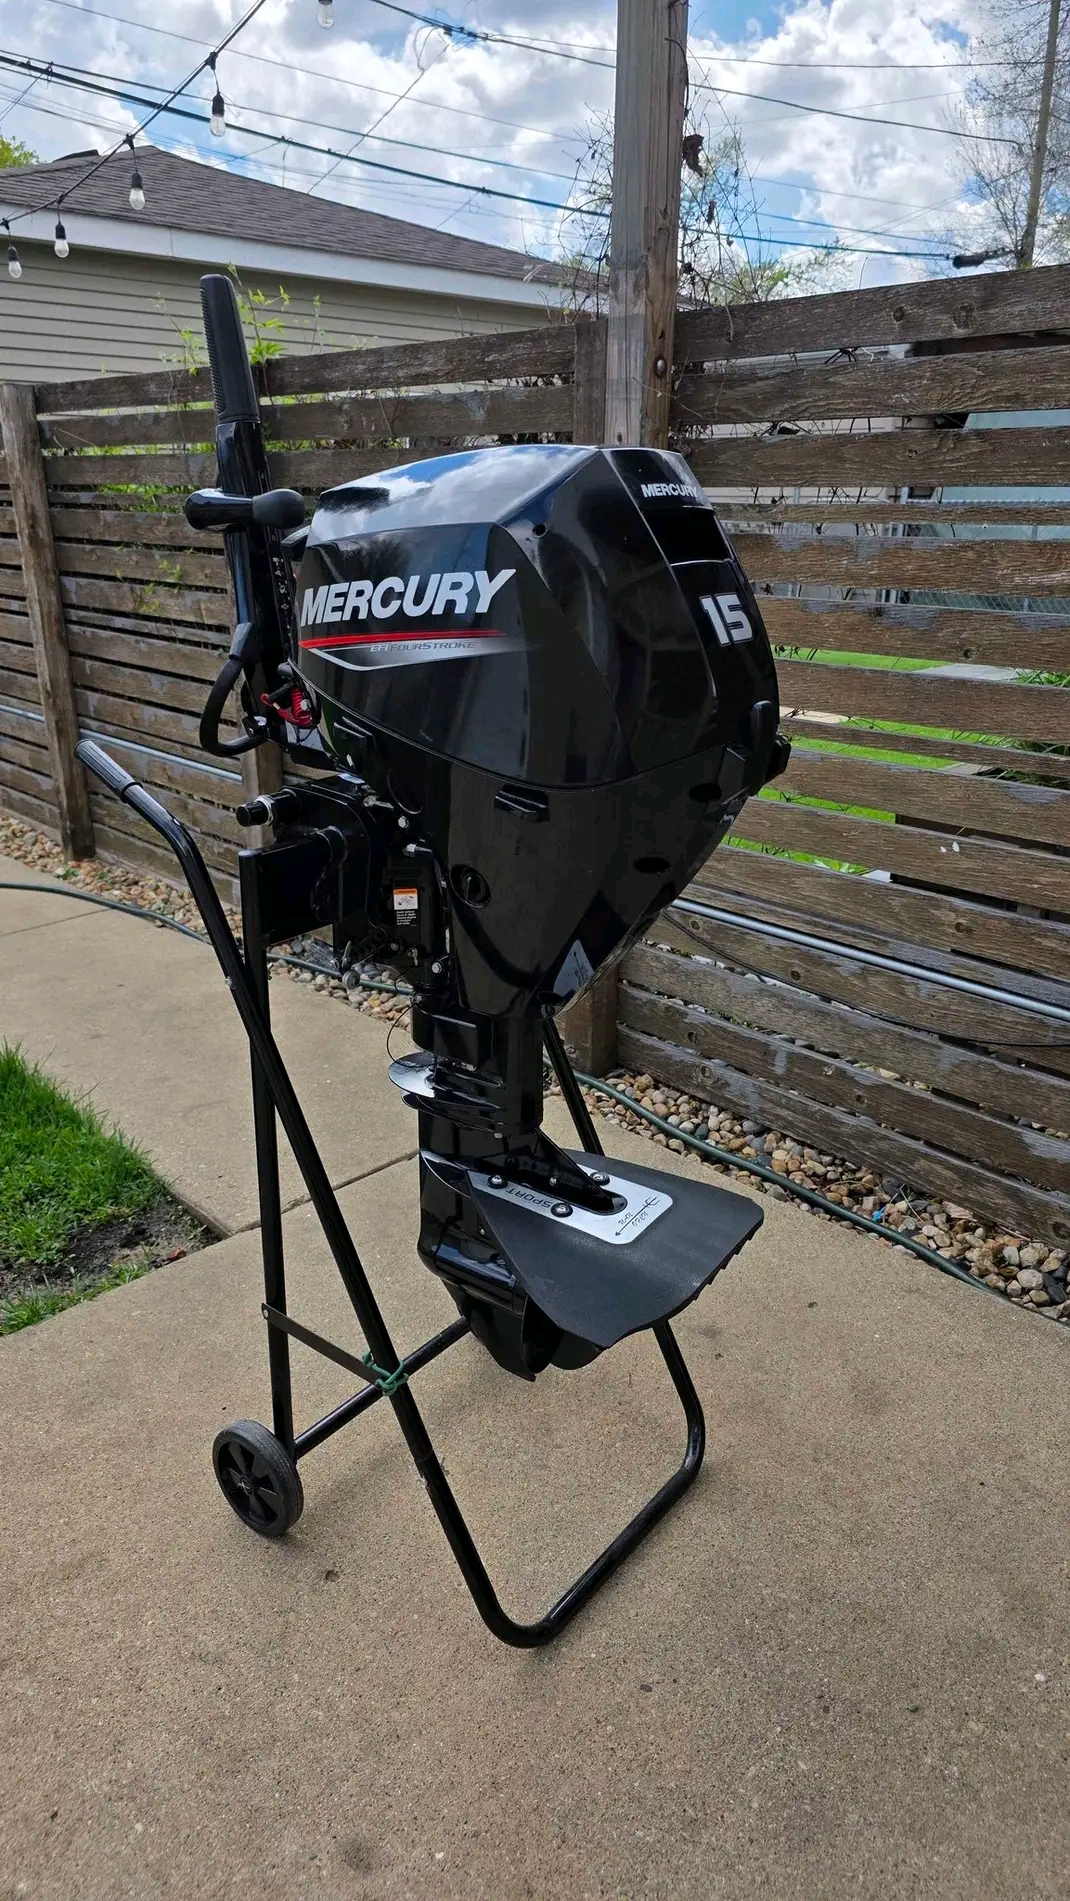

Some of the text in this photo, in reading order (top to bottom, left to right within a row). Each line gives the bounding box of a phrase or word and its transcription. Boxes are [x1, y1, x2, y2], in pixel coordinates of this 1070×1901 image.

[640, 483, 698, 498] MERCURY
[300, 568, 517, 627] MERCURY
[700, 592, 753, 647] 15
[505, 1187, 554, 1209] SPORT
